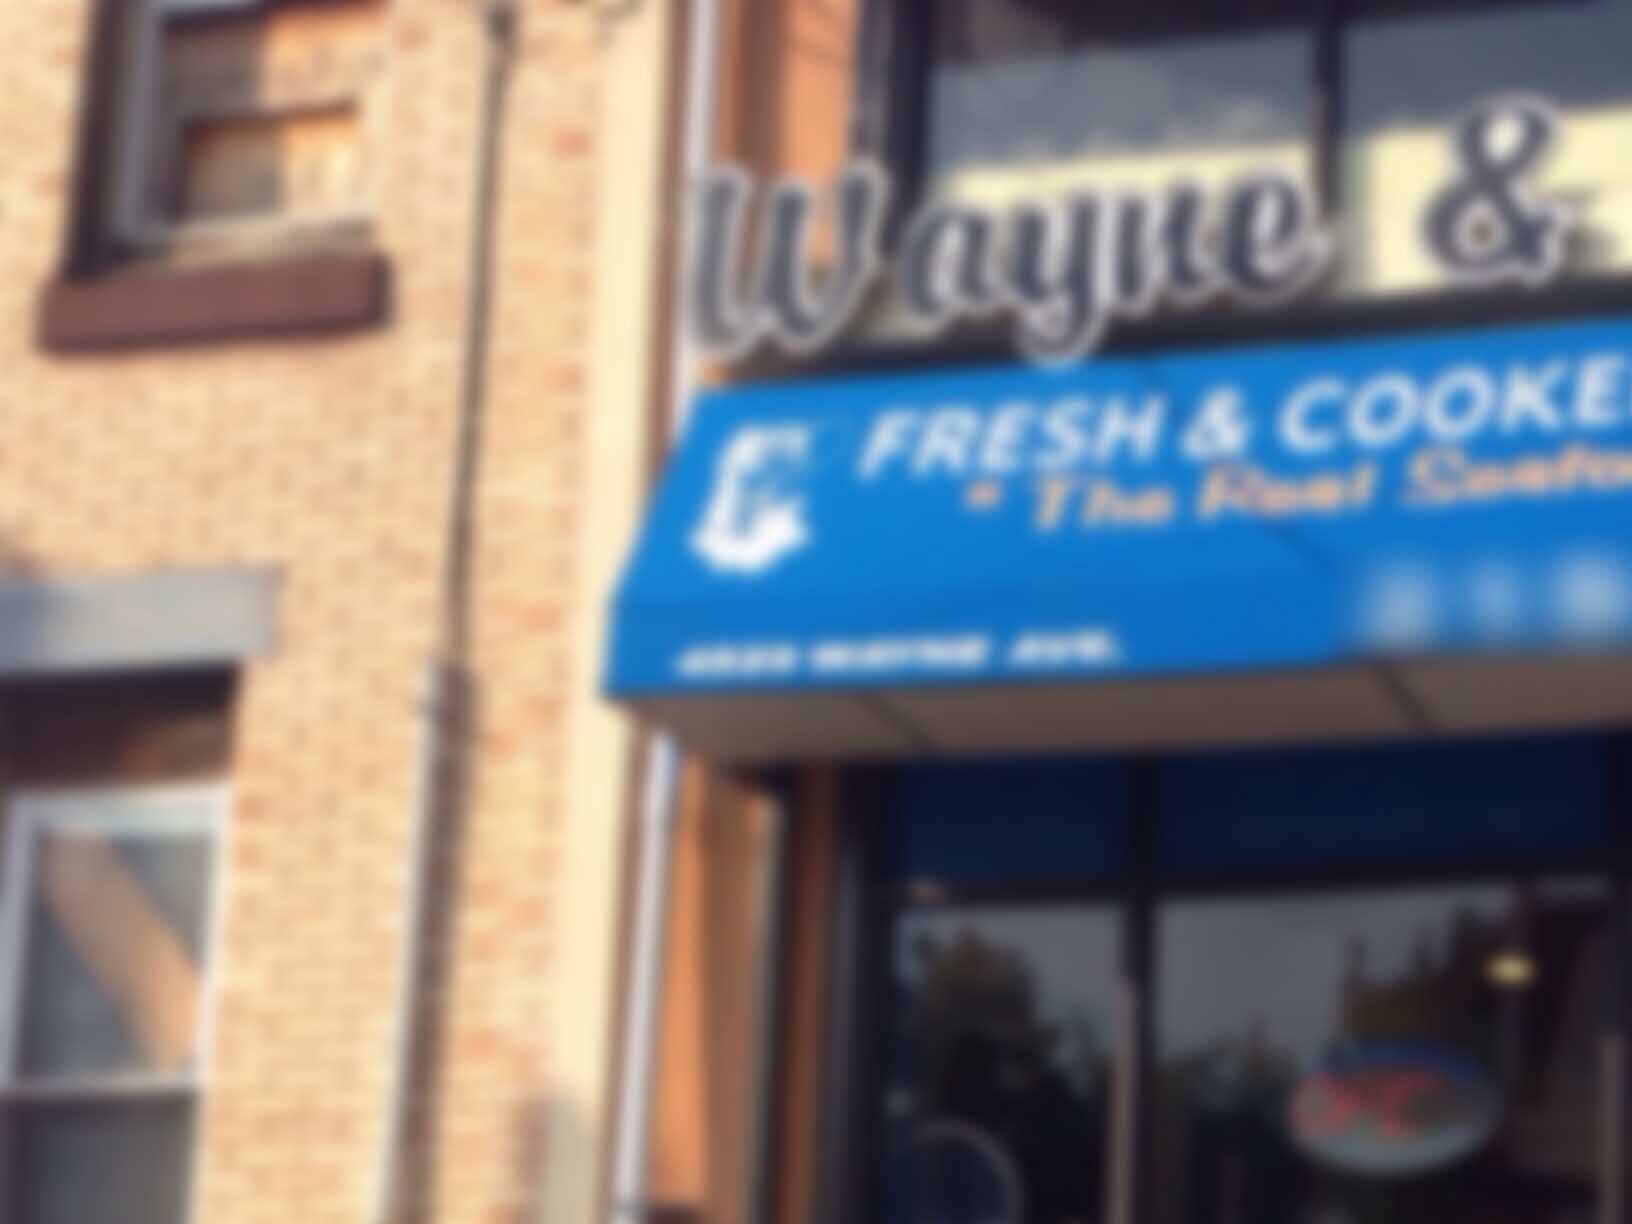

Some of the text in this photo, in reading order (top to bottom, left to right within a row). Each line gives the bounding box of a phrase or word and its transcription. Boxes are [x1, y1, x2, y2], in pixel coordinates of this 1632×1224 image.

[691, 161, 1334, 365] Wayne
[1422, 96, 1563, 284] &
[858, 404, 1160, 482] FRESH
[1180, 385, 1252, 460] &
